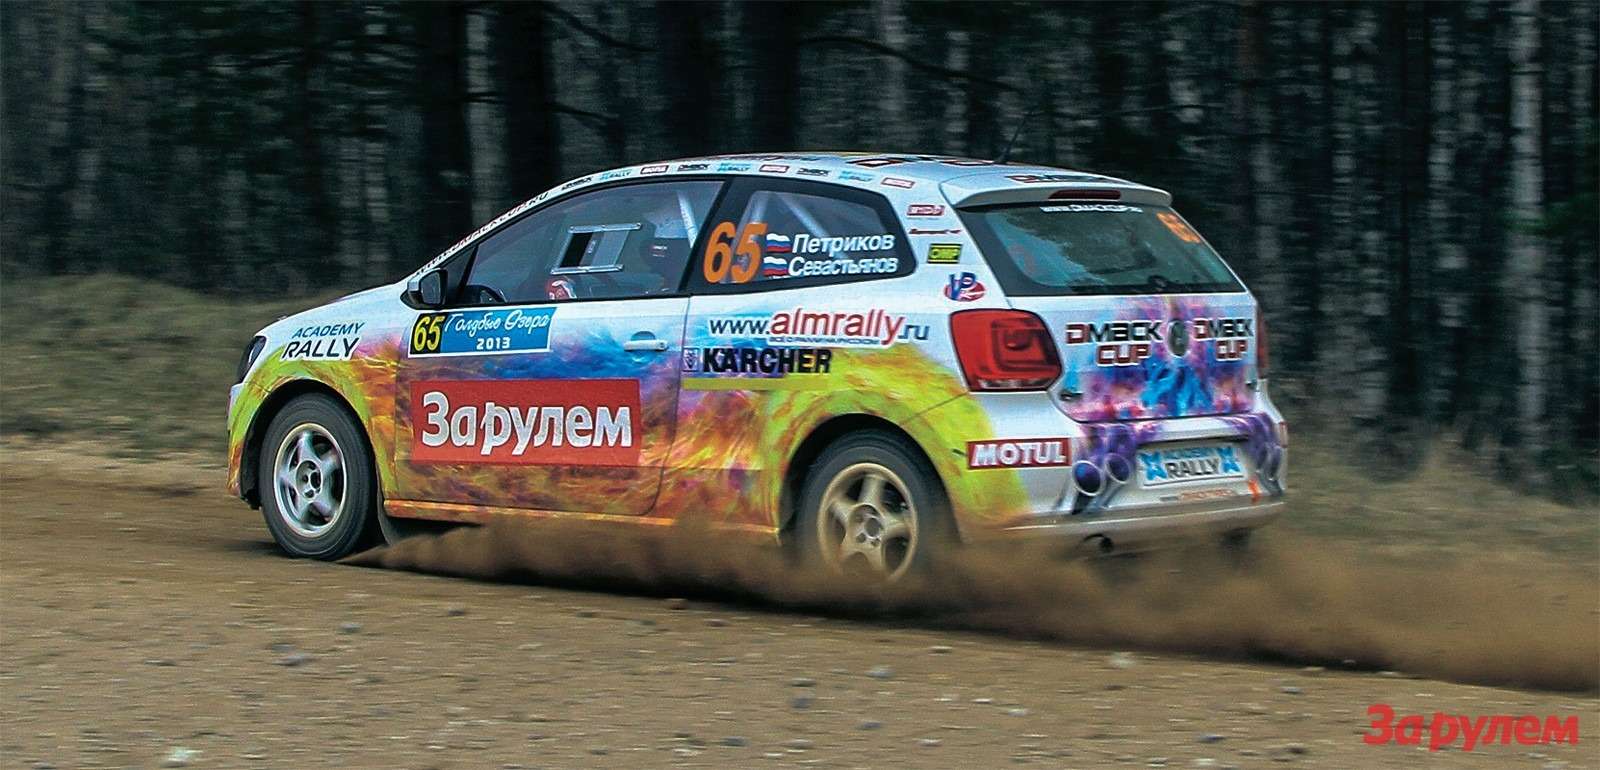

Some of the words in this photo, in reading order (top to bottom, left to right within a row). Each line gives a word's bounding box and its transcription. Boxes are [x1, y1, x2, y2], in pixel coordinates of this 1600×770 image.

[703, 221, 768, 283] 65
[792, 233, 895, 257] Петриков
[787, 256, 898, 277] Севастьянов
[292, 321, 365, 339] ACADEMY
[412, 315, 445, 351] 65
[504, 309, 549, 335] Озера
[709, 308, 930, 345] www.almrally.ru
[281, 337, 360, 359] RALLY
[476, 337, 511, 350] 2013
[1097, 344, 1151, 366] CUP
[972, 440, 1067, 466] MOTUL
[1165, 458, 1221, 479] RALLY
